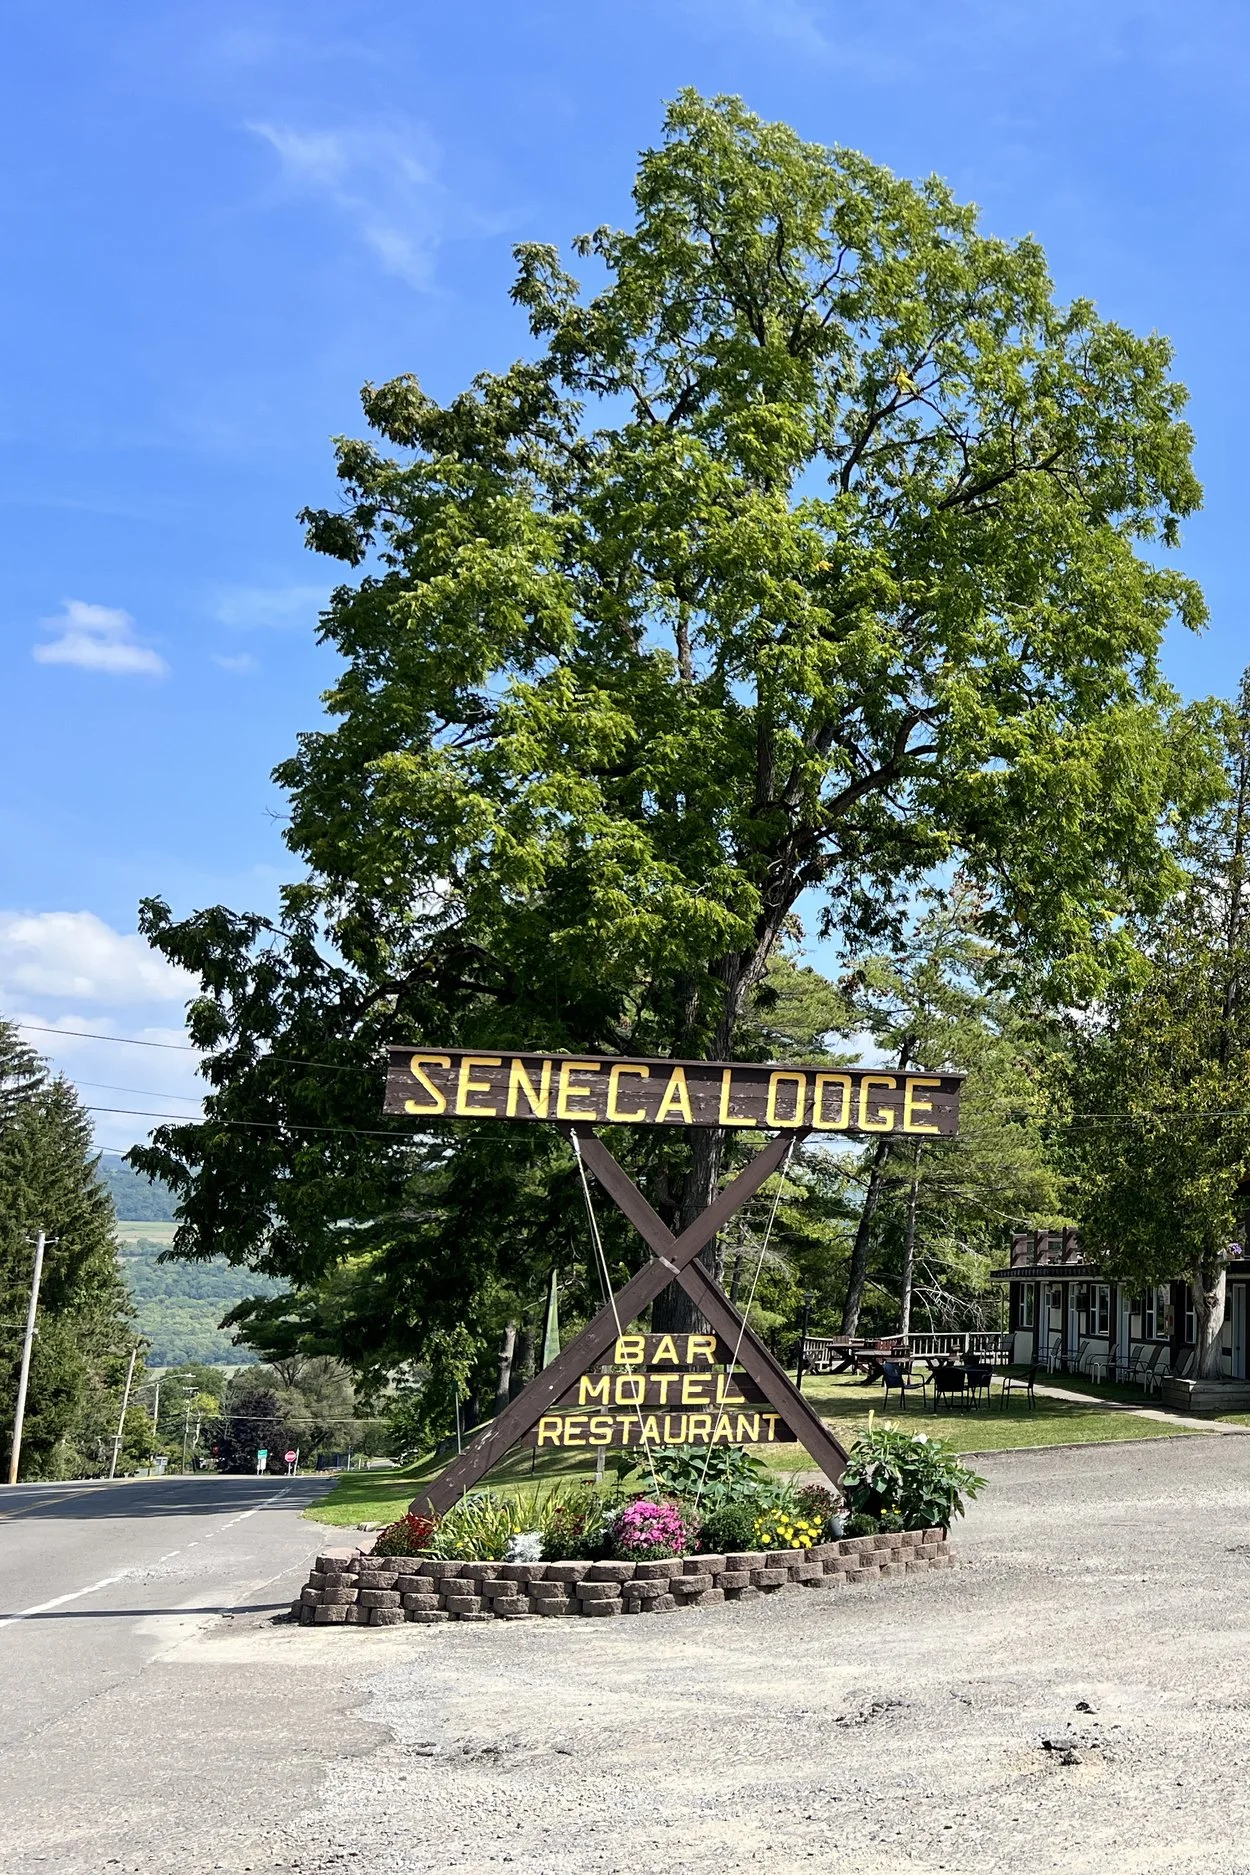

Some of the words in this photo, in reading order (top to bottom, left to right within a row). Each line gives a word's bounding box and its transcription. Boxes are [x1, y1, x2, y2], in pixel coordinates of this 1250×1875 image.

[404, 1054, 693, 1125] SENECA
[718, 1069, 941, 1134] LODGE
[614, 1334, 717, 1365] BAR
[578, 1374, 746, 1406] MOTEL
[537, 1413, 783, 1447] RESTAURANT
